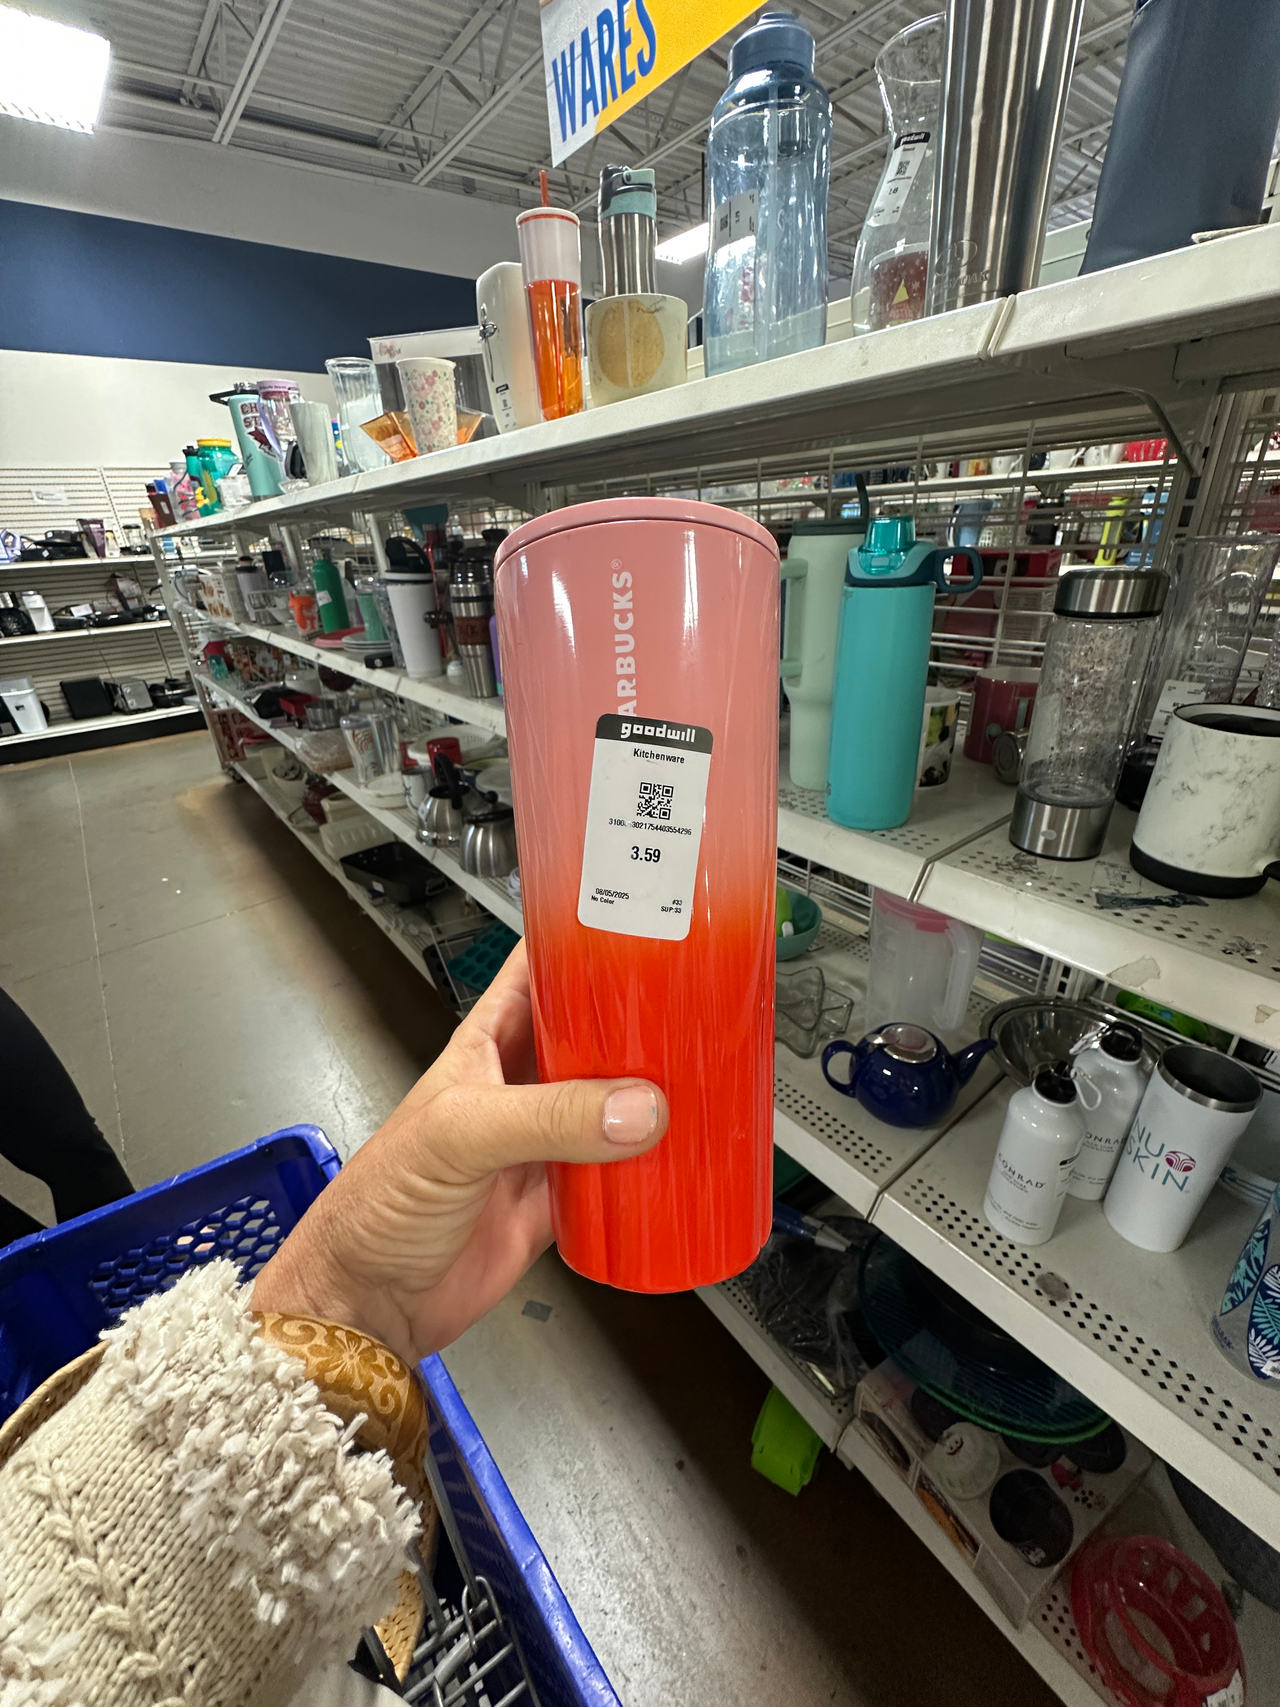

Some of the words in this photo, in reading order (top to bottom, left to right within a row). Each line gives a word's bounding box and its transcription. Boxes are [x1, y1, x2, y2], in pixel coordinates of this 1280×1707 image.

[552, 0, 656, 143] WARES
[611, 570, 637, 717] ARBUCKS
[620, 722, 696, 743] goodwill
[632, 748, 685, 764] Kitchenware
[630, 845, 661, 863] 3.59
[595, 887, 630, 900] 08/05/2025
[599, 896, 615, 905] Color
[1132, 1117, 1165, 1157] NU
[1126, 1135, 1190, 1191] SKIN
